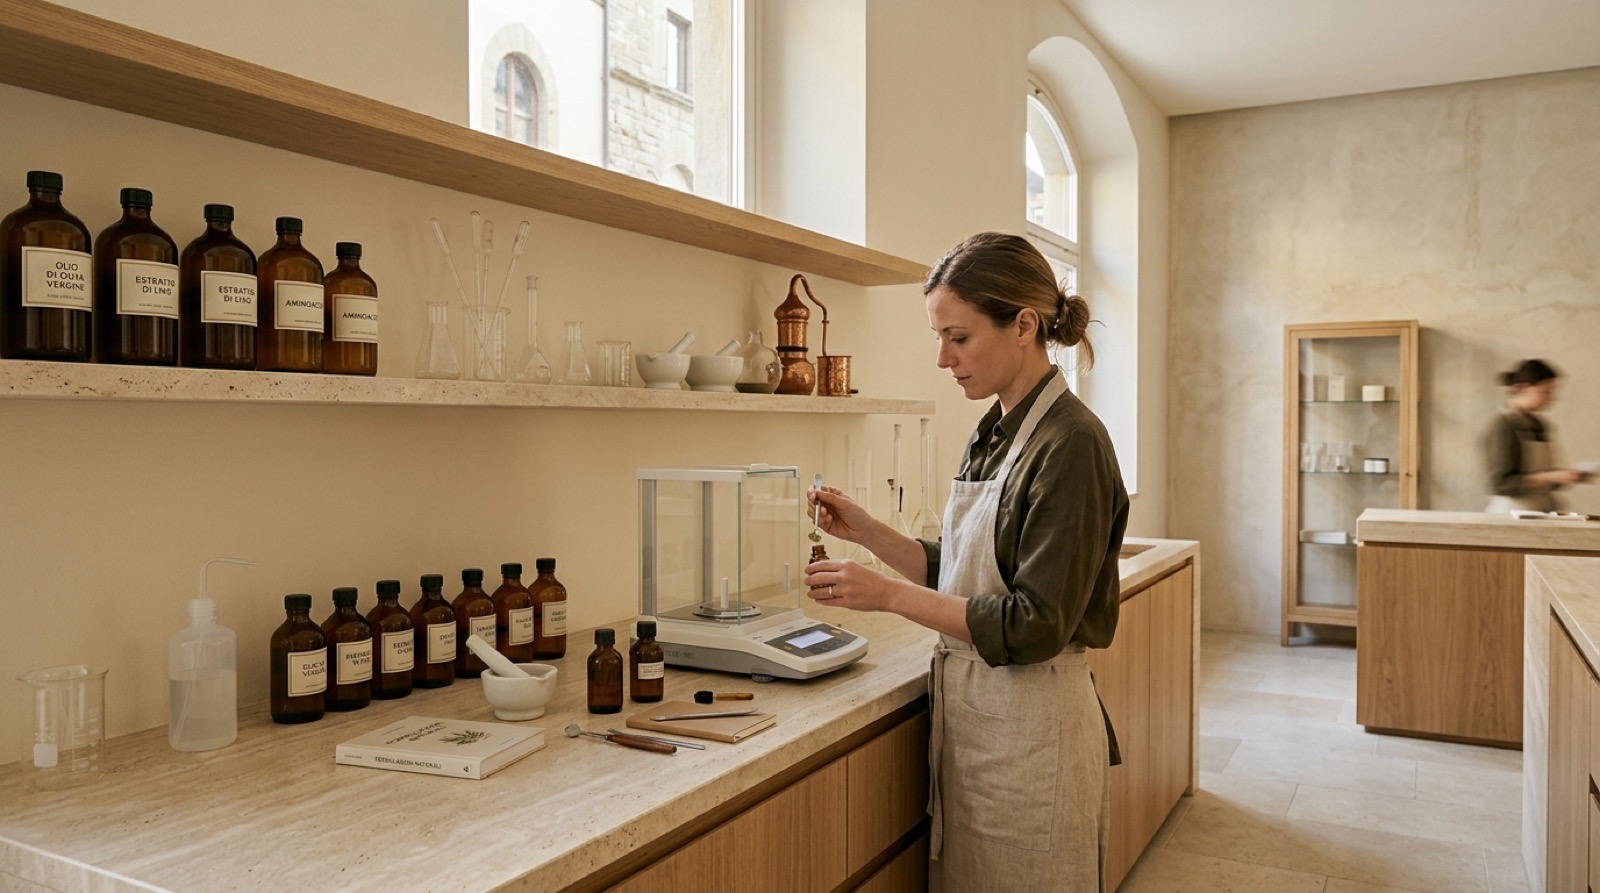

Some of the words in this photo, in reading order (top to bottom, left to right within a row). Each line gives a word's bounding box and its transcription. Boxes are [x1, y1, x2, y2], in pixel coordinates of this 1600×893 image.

[55, 262, 78, 271] OLIO
[46, 270, 58, 279] DI
[46, 281, 84, 291] VERGINE
[142, 285, 152, 294] DI
[223, 294, 233, 303] DI
